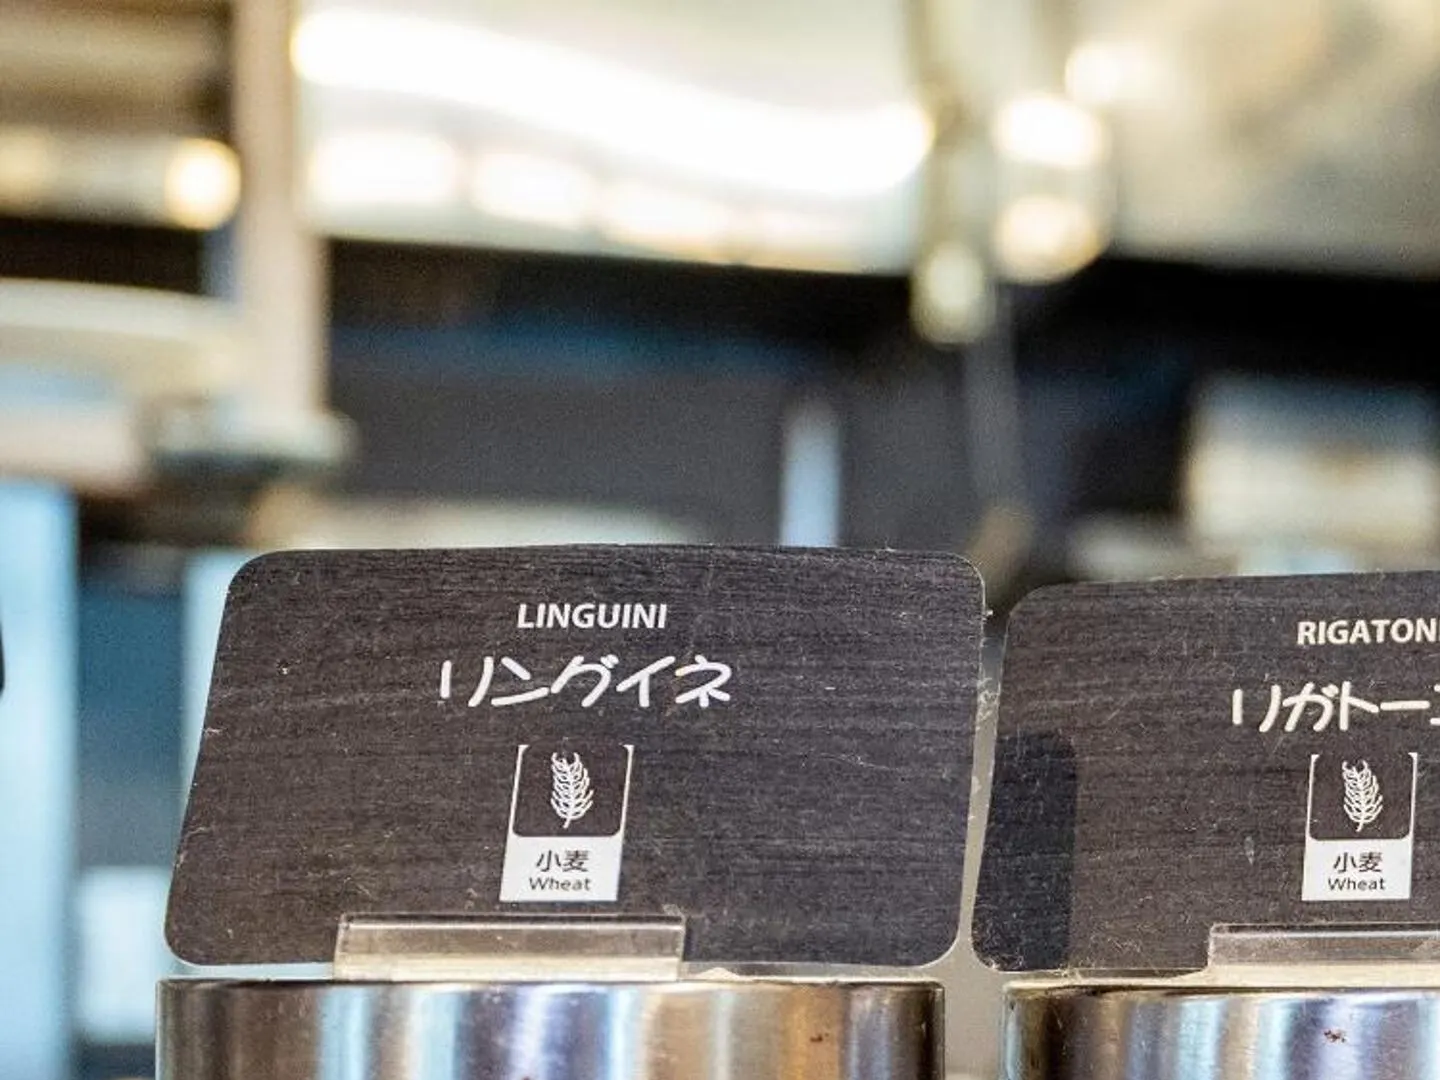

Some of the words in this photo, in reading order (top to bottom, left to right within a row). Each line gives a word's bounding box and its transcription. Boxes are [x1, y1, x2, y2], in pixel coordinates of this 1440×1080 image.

[516, 602, 668, 630] LINGUINI
[439, 653, 734, 708] リングイネ
[534, 847, 591, 874] 小麦
[1332, 850, 1384, 874] 小麦
[528, 876, 592, 893] Wheat
[1326, 875, 1386, 892] Wheat
